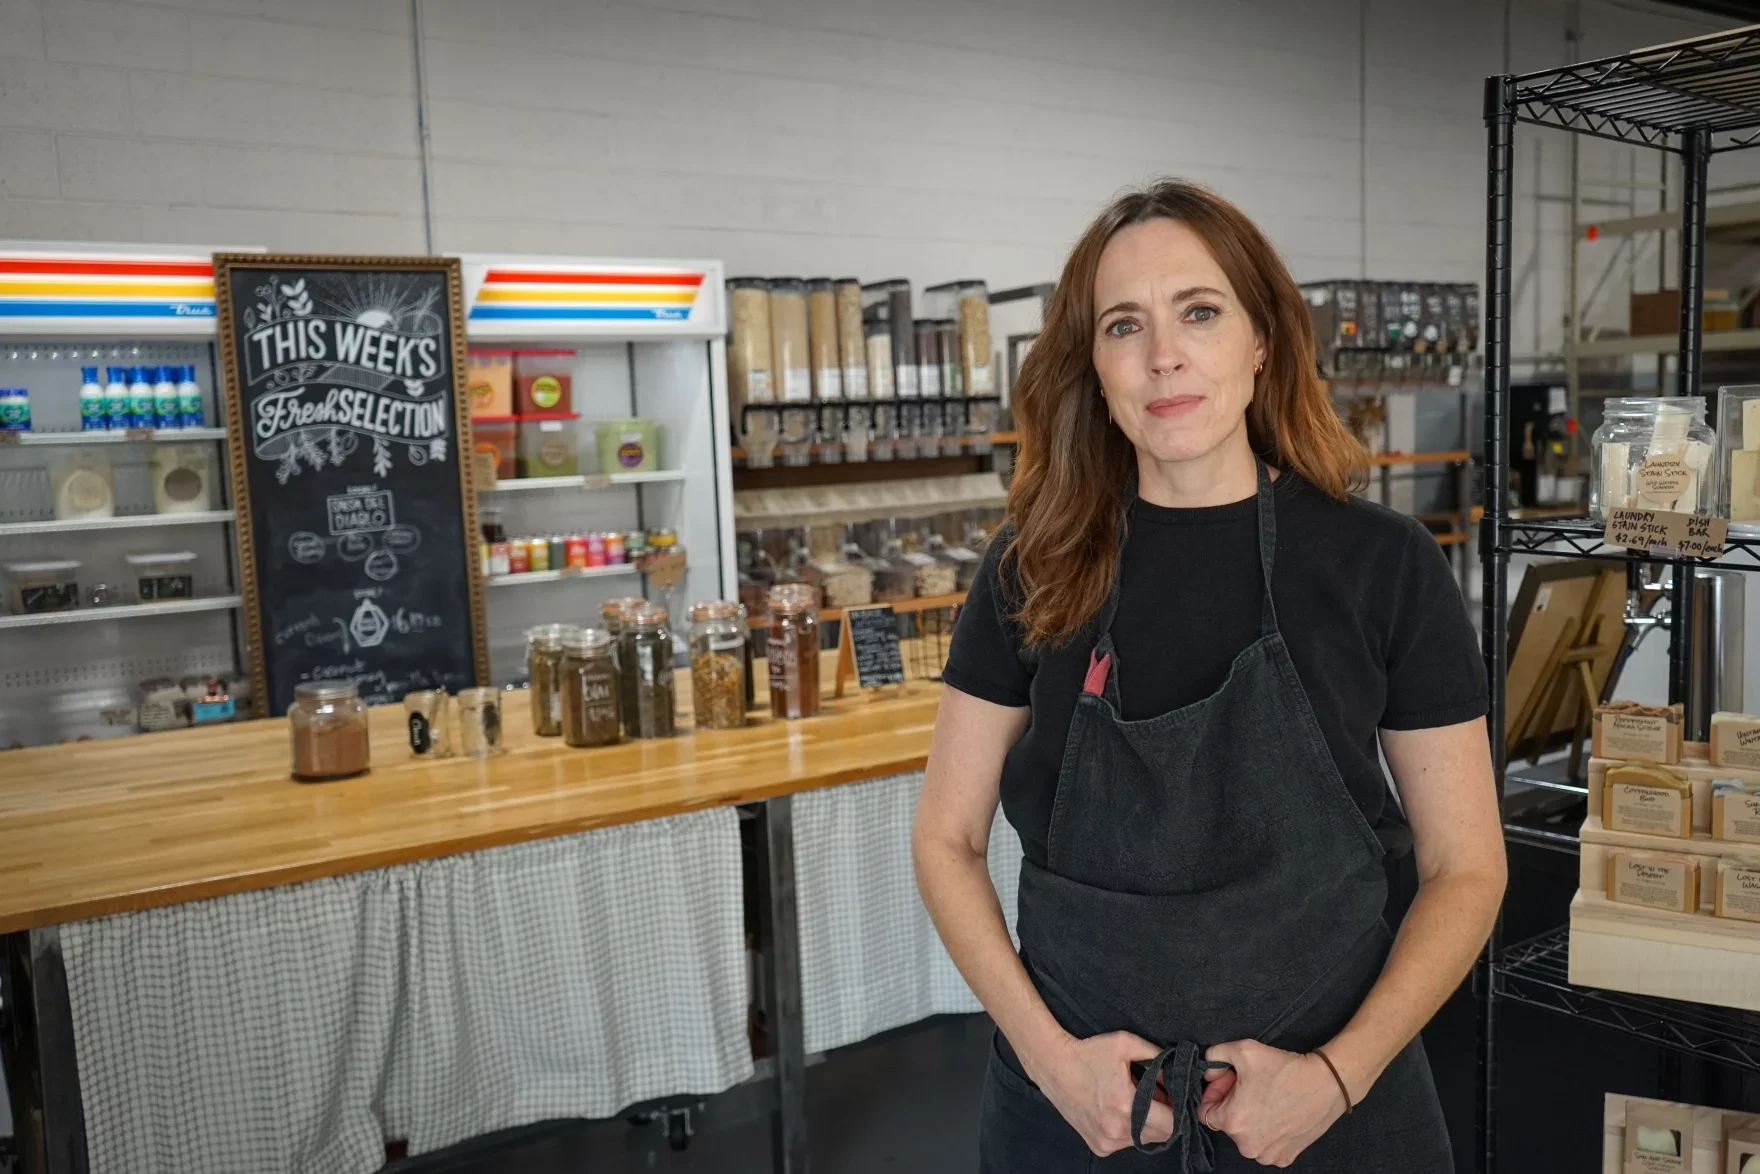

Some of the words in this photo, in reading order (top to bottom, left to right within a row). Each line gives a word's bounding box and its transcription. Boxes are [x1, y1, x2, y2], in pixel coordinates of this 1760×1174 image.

[252, 319, 327, 370] THIS
[256, 386, 339, 439] Fresh
[338, 387, 446, 438] SELECTION
[1614, 511, 1655, 522] LAUNDRY
[1612, 520, 1638, 531] STAIN
[1640, 522, 1669, 536] STICK
[1688, 527, 1710, 538] BAR
[1677, 539, 1723, 556] $7.00/each
[1736, 872, 1757, 881] LOST
